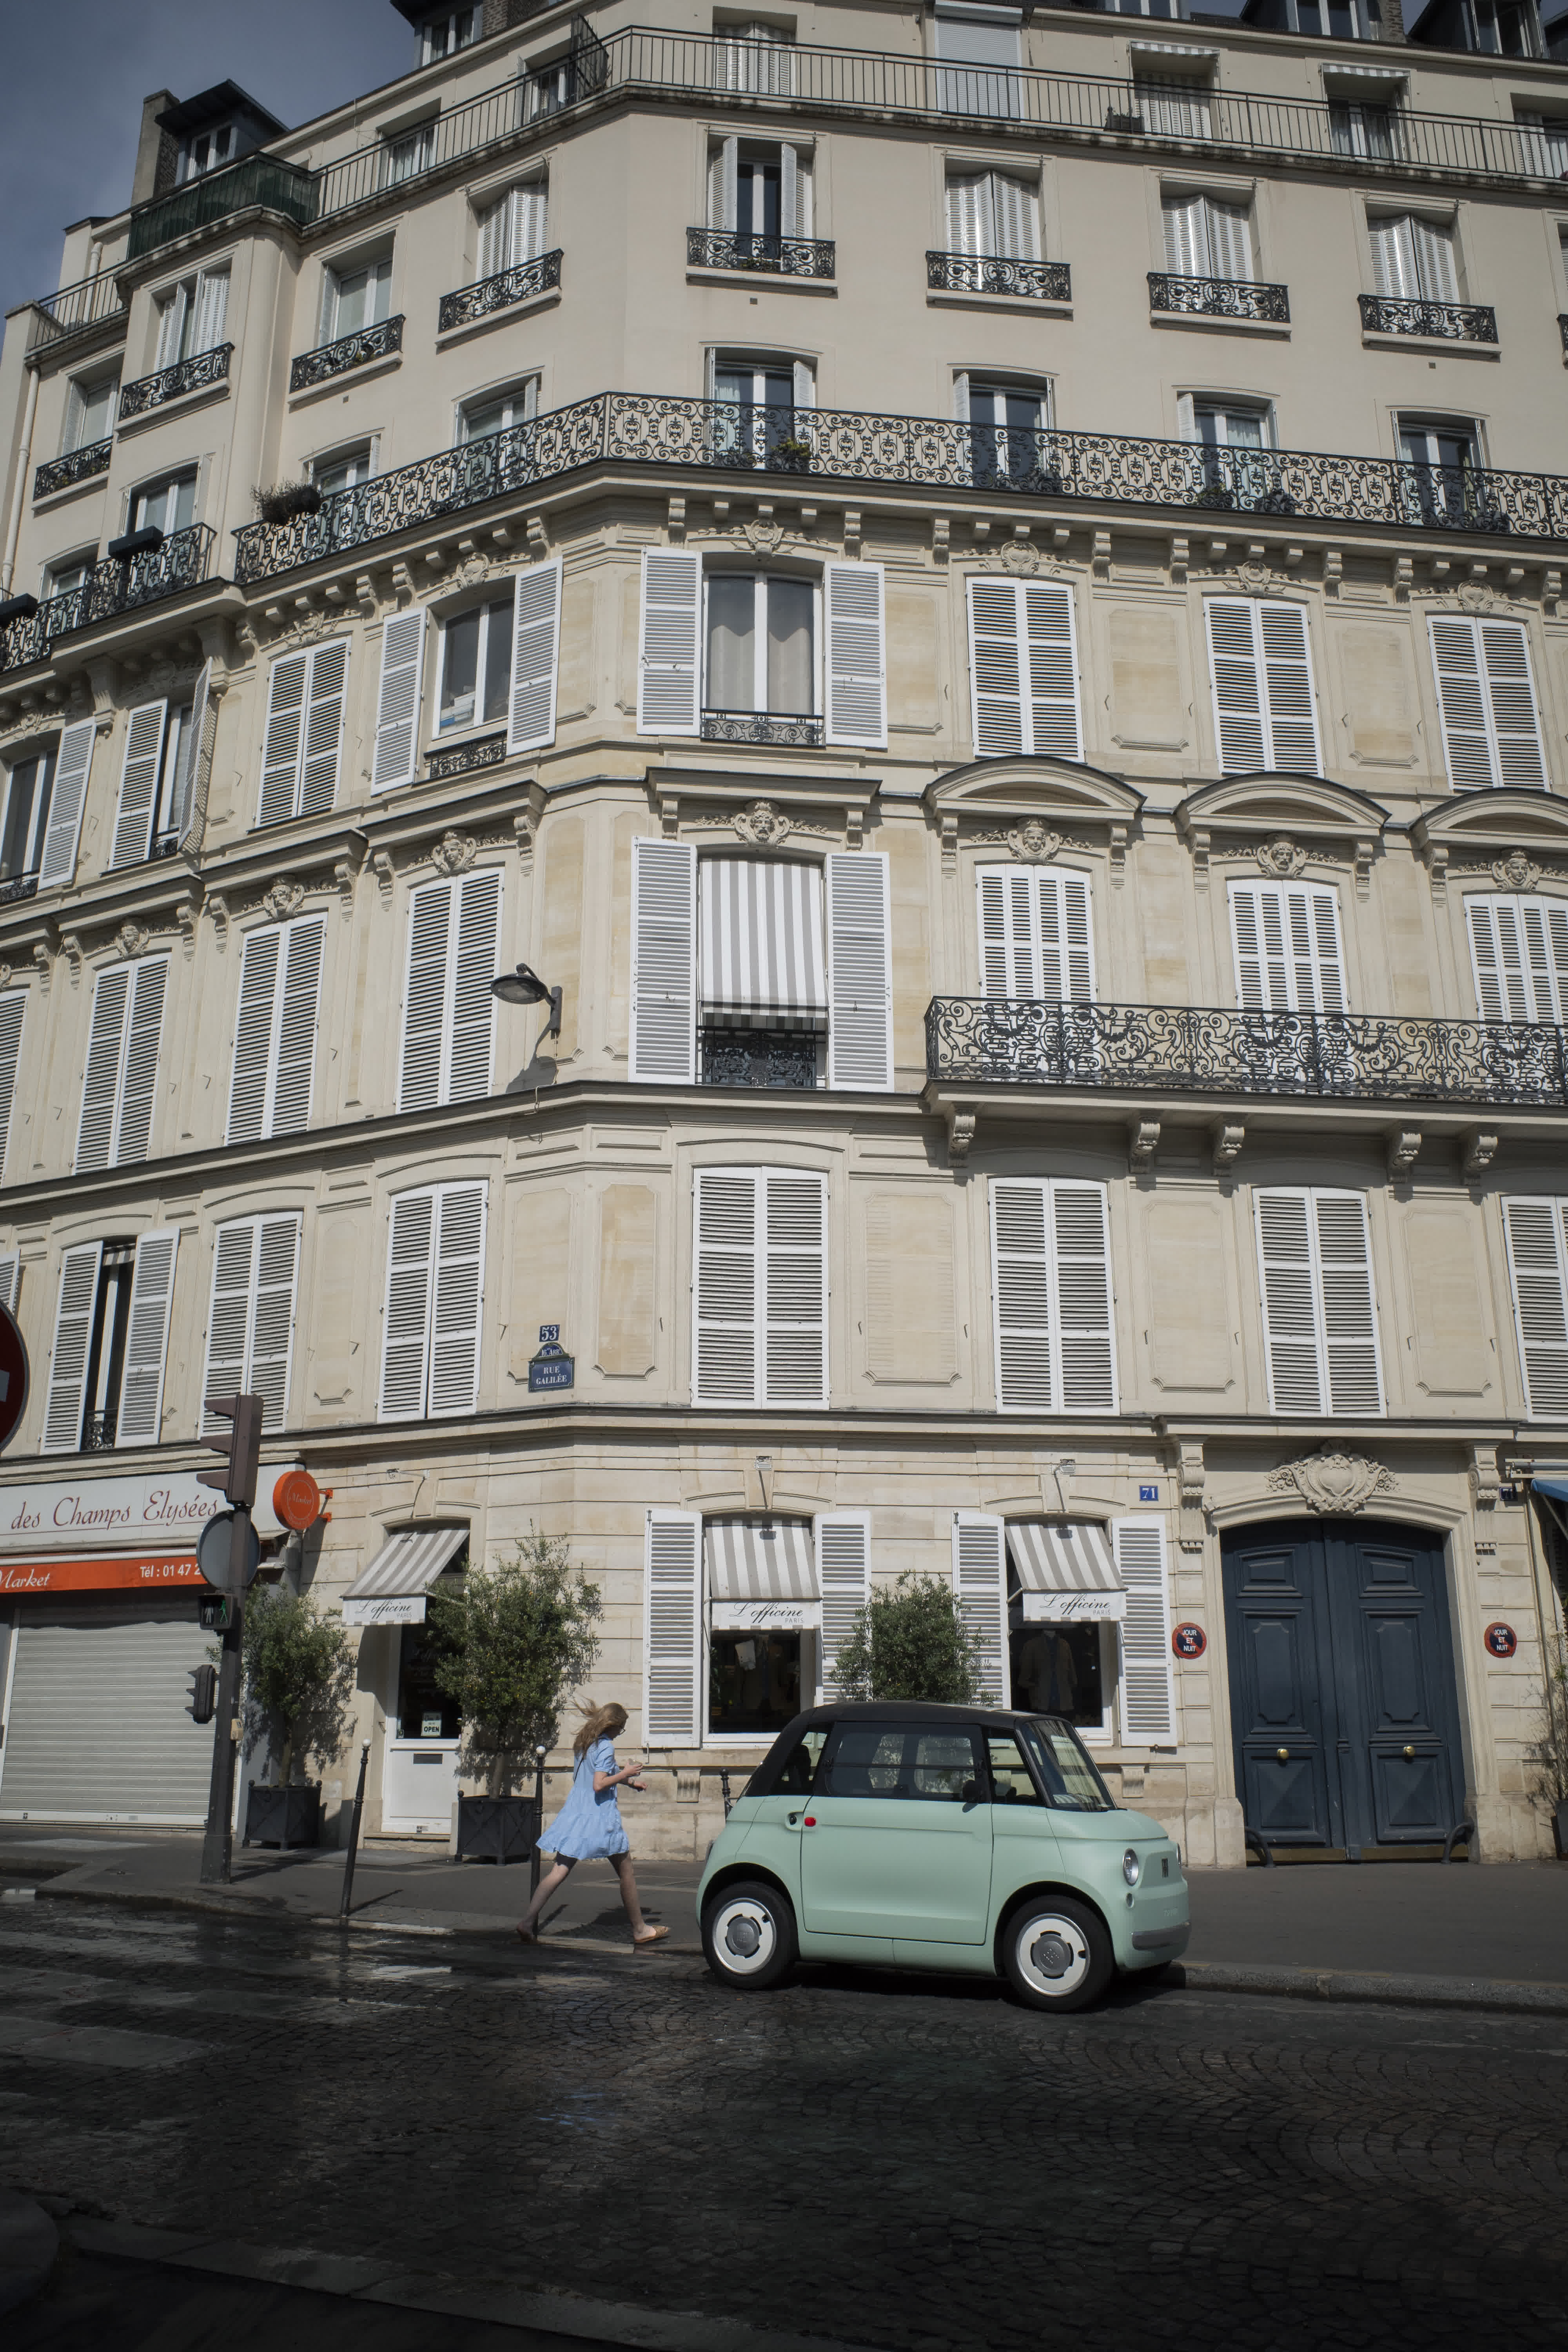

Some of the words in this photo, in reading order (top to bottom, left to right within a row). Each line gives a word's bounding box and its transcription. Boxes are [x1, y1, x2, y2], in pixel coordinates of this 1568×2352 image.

[542, 1326, 557, 1341] 53
[544, 1366, 559, 1374] RUE
[536, 1374, 567, 1385] GALILÉE
[1142, 1488, 1155, 1499] 71
[11, 1501, 40, 1529] des
[53, 1496, 130, 1530] Champs
[144, 1490, 217, 1526] Elysées
[140, 1564, 154, 1577] Tél
[163, 1565, 174, 1577] 01
[178, 1564, 191, 1575] 47
[354, 1599, 412, 1619] L'officine
[1038, 1593, 1111, 1615] L'officine
[728, 1602, 803, 1624] L'officine
